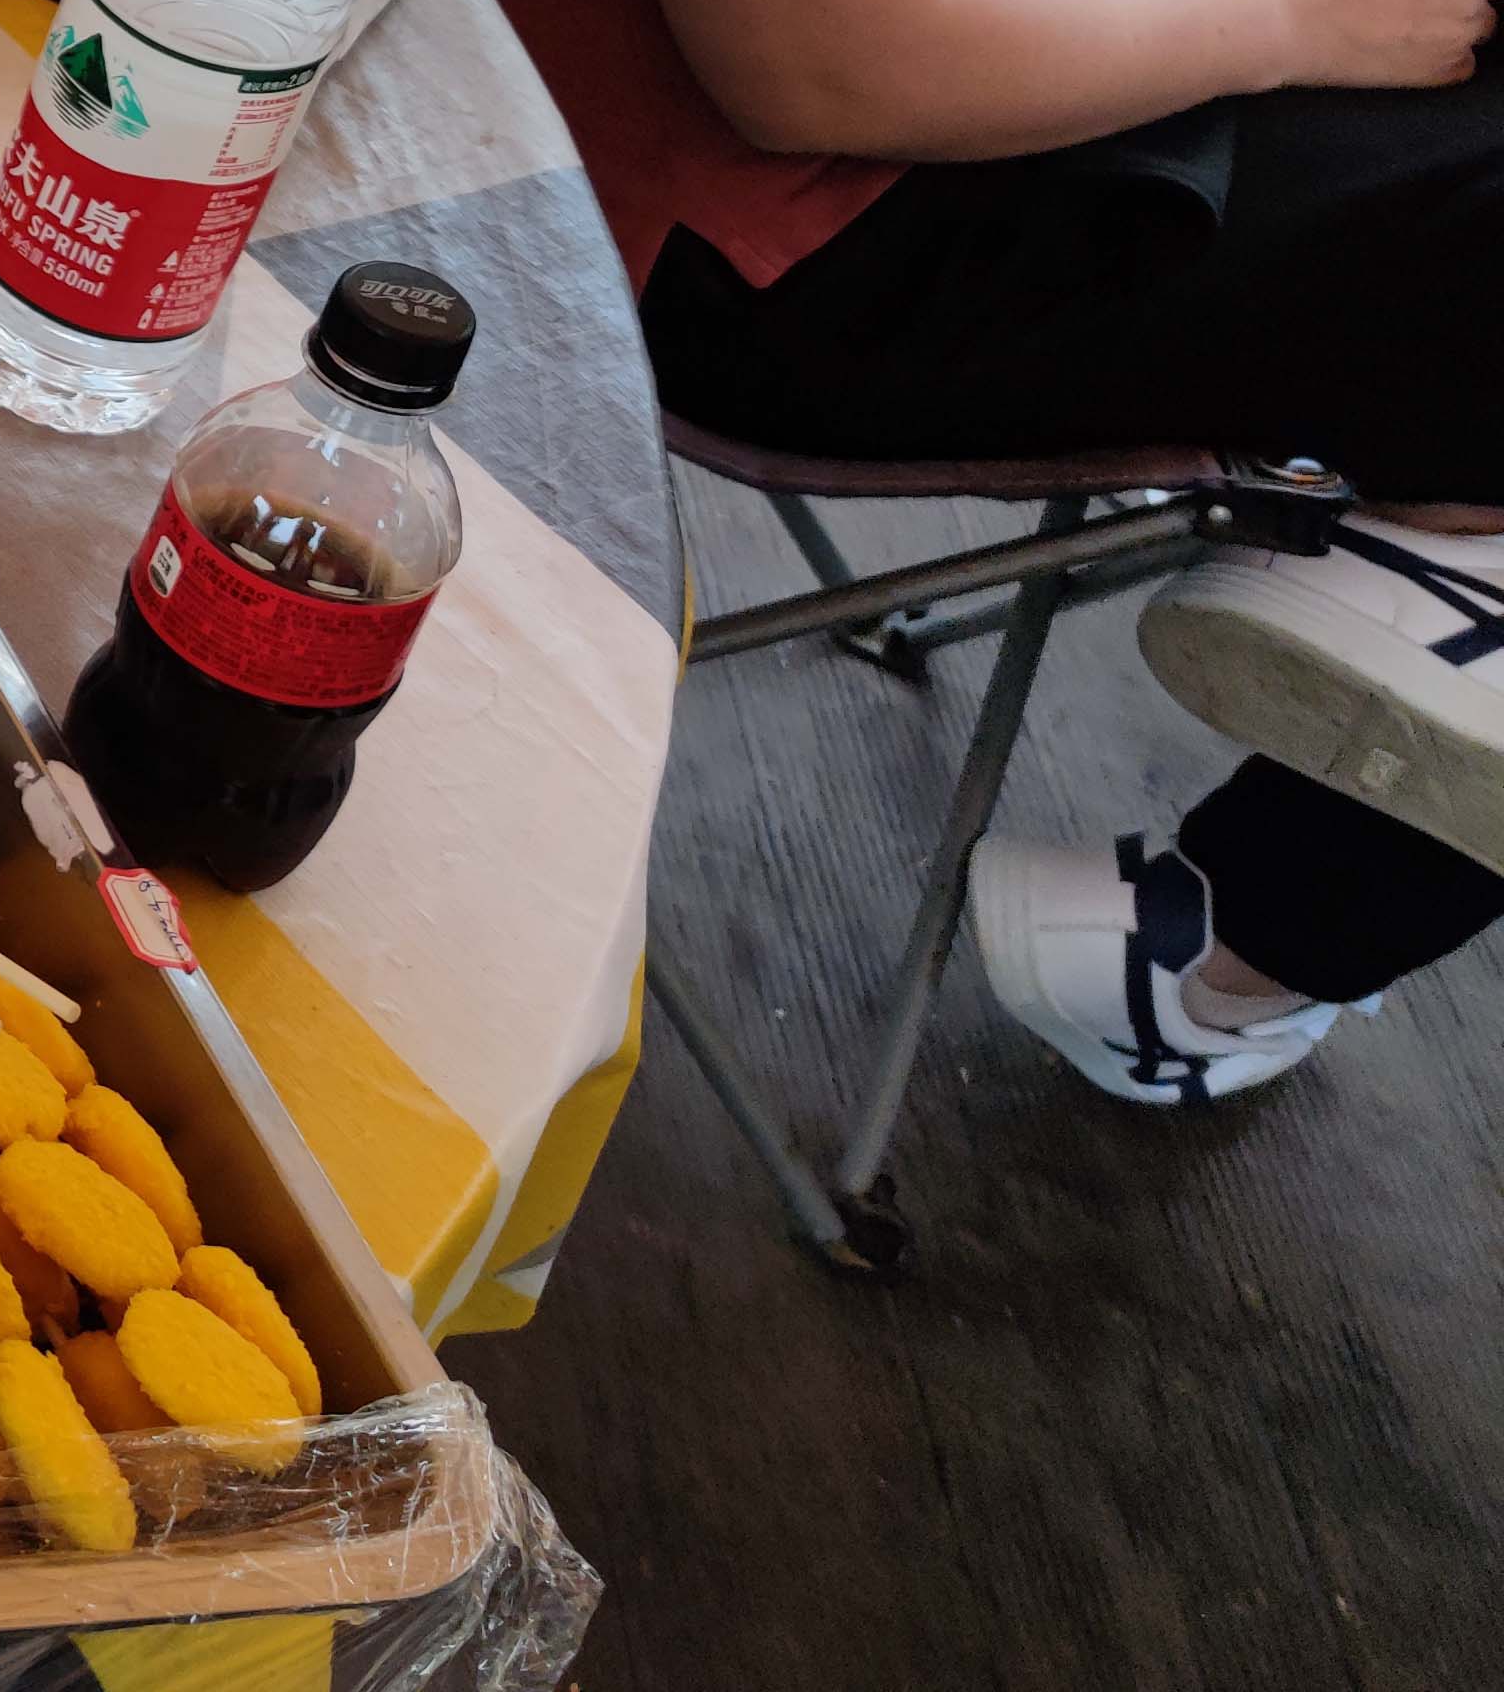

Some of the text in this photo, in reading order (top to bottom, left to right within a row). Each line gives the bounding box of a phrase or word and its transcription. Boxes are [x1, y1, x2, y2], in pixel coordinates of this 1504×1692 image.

[26, 214, 116, 278] SPRING
[359, 278, 457, 311] 可口可乐
